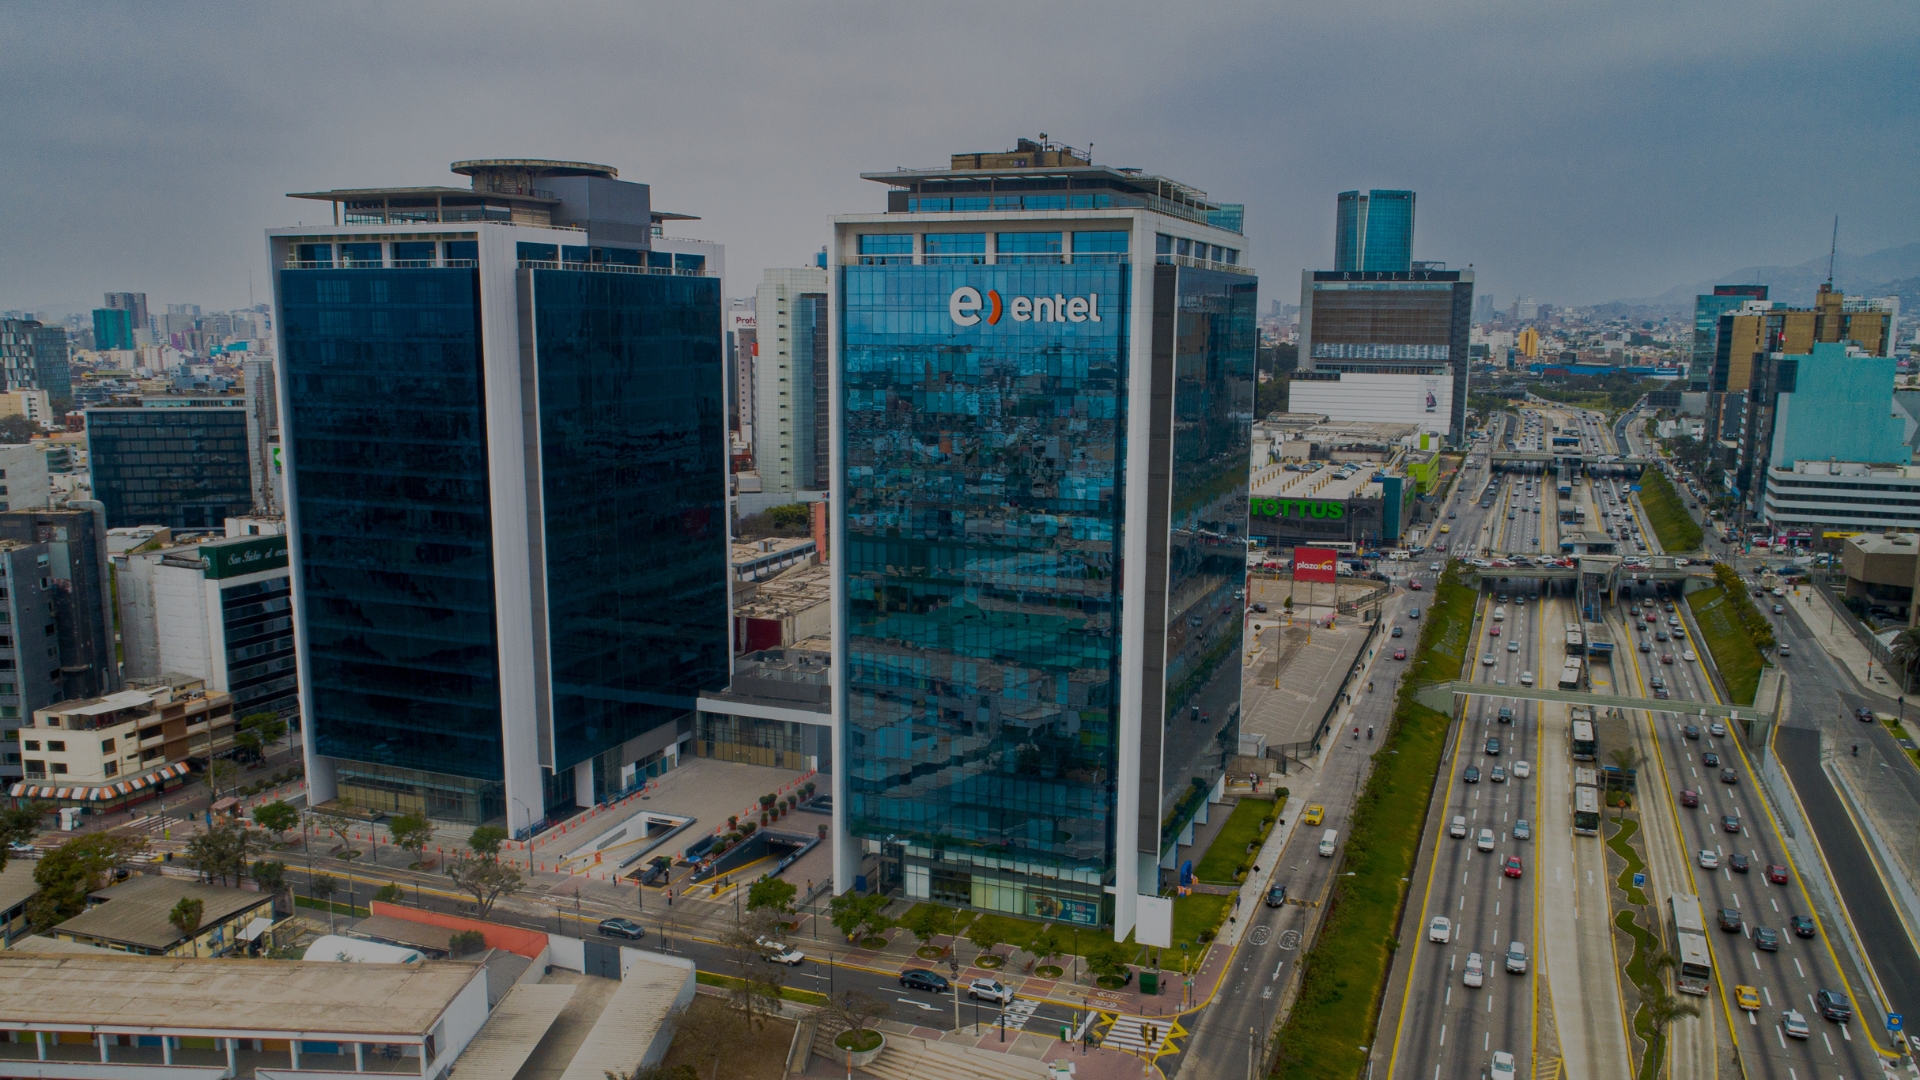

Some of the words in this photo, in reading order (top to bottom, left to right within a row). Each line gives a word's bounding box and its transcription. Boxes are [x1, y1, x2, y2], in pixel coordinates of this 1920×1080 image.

[1343, 271, 1431, 281] RIPLEY
[1011, 293, 1101, 322] entel
[1250, 498, 1343, 519] TOTTUS
